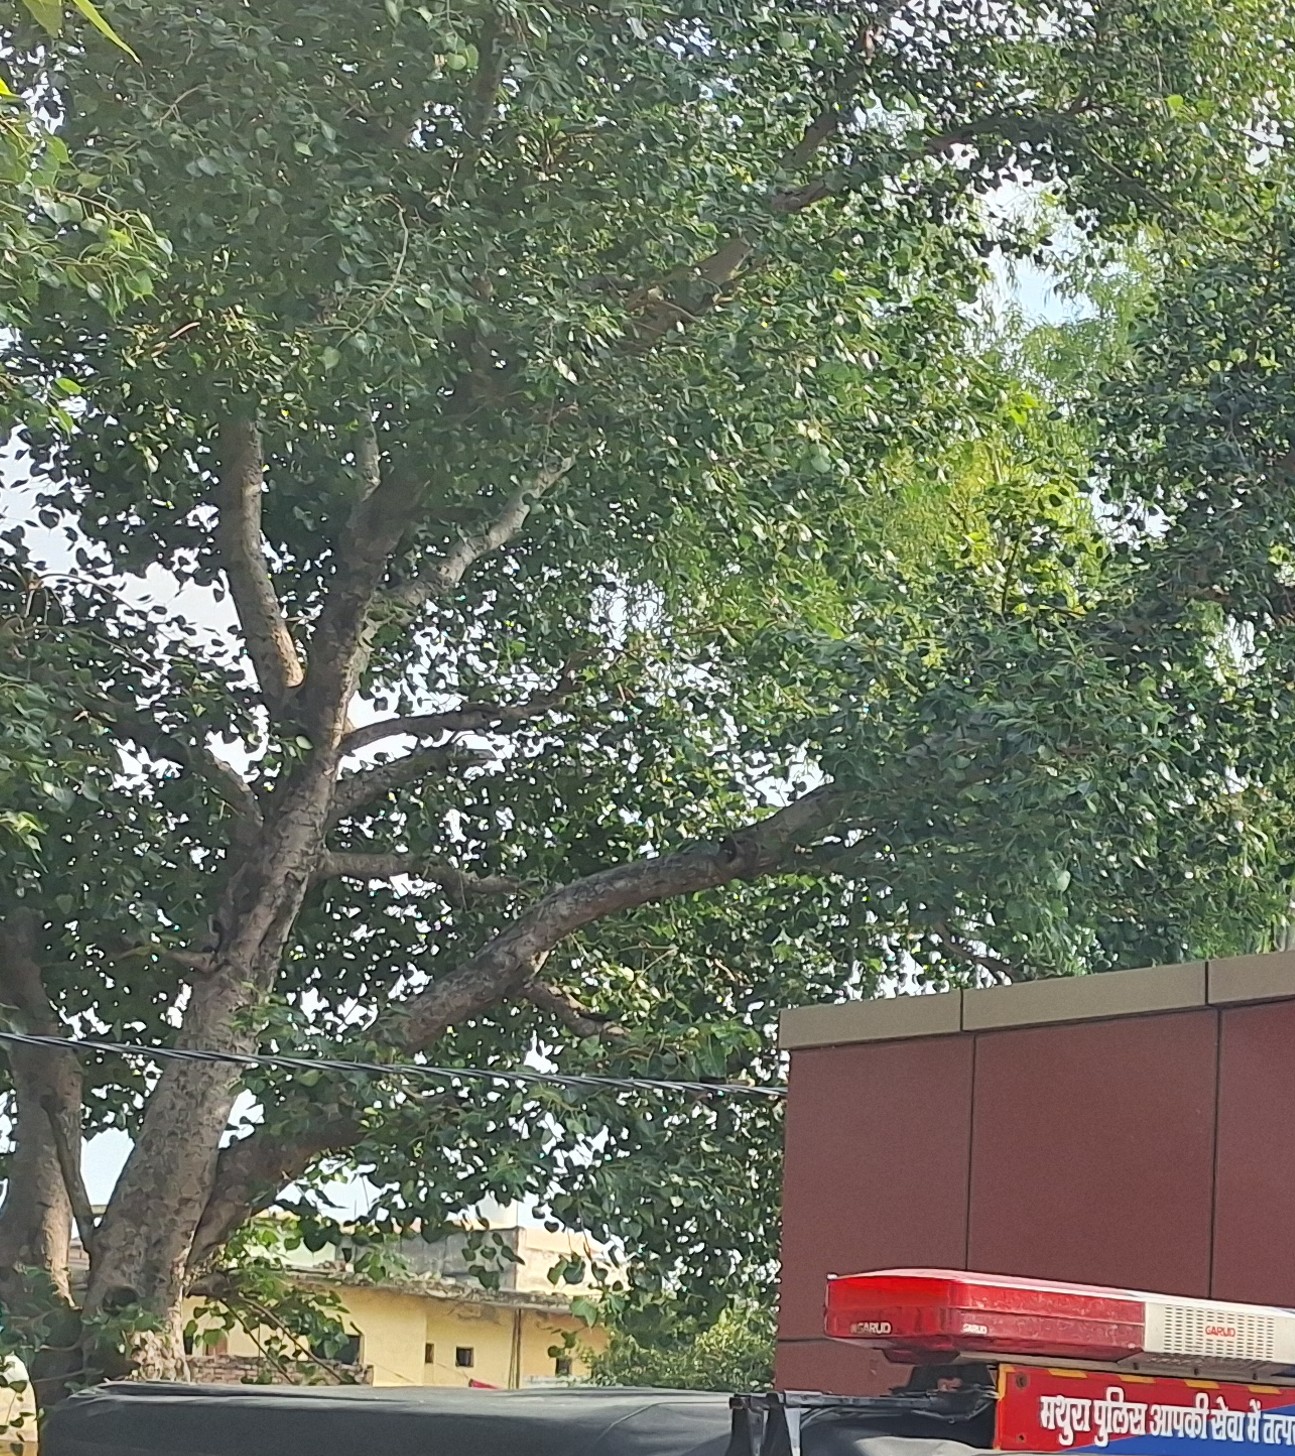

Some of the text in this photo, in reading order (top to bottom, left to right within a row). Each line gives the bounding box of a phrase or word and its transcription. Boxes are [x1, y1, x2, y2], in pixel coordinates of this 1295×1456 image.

[1205, 1325, 1237, 1338] GARUD
[1040, 1394, 1092, 1446] मथुरा
[1093, 1386, 1148, 1447] पुलिस
[1150, 1392, 1209, 1440] आपकी
[1210, 1395, 1244, 1442] सेवा
[1246, 1398, 1262, 1444] में
